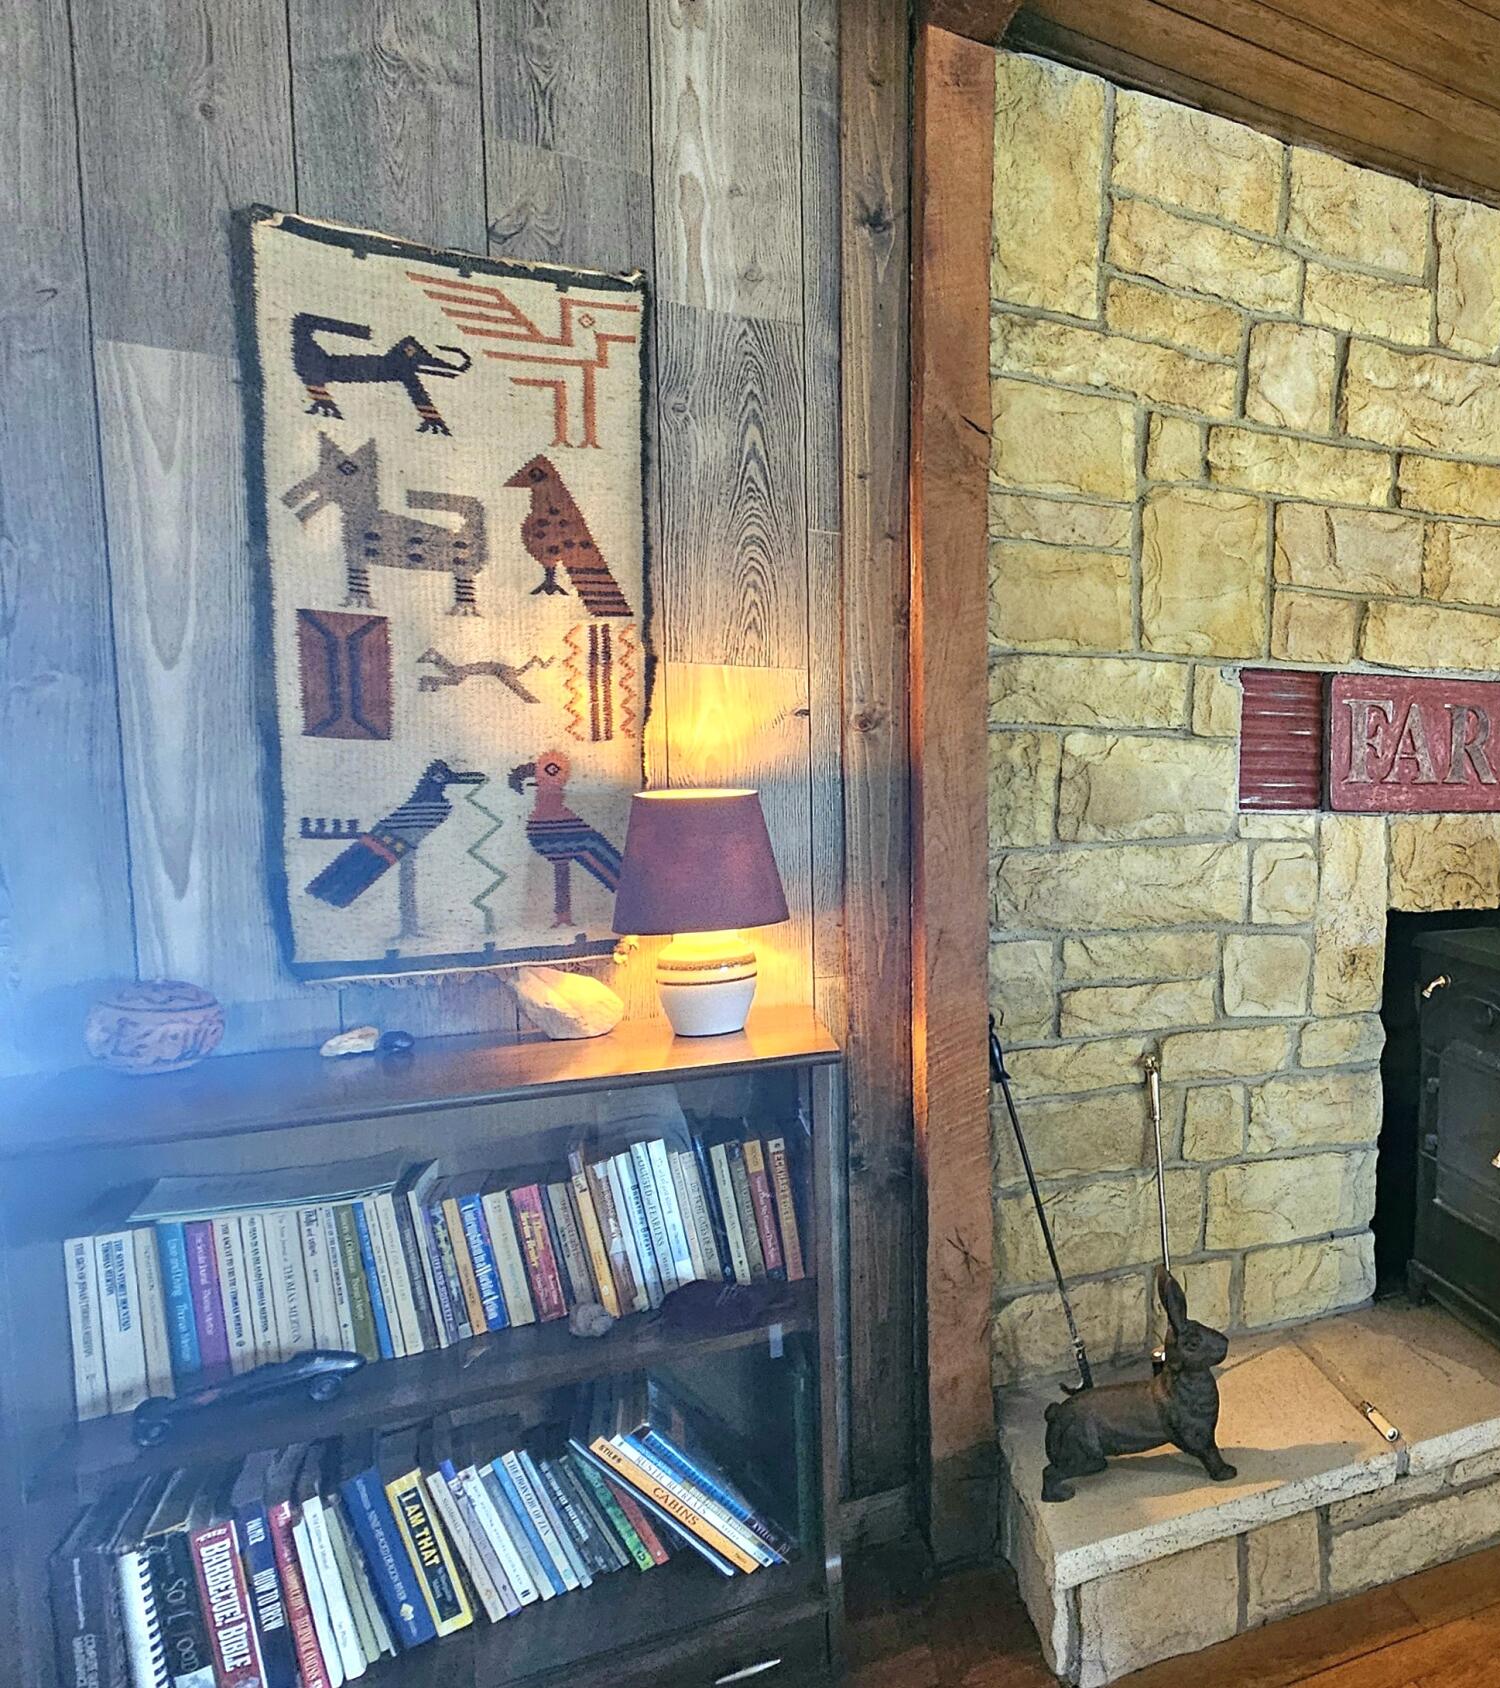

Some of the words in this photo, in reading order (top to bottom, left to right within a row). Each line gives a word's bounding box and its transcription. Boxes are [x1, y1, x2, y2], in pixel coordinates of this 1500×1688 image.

[774, 1153, 789, 1195] ECKHART
[635, 1154, 653, 1196] FOCUSED
[648, 1205, 664, 1246] FEARLESS
[402, 1492, 416, 1502] I
[636, 1457, 664, 1482] RUSTIC
[666, 1481, 707, 1515] RETREATS
[405, 1504, 425, 1528] AM
[653, 1487, 698, 1526] CABINS
[246, 1517, 265, 1545] PALMER
[415, 1526, 440, 1566] THAT
[200, 1538, 245, 1627] BARBECUE!
[253, 1568, 278, 1593] HOW
[256, 1589, 279, 1606] TO
[259, 1602, 285, 1632] BREW
[217, 1622, 252, 1672] BIBLE
